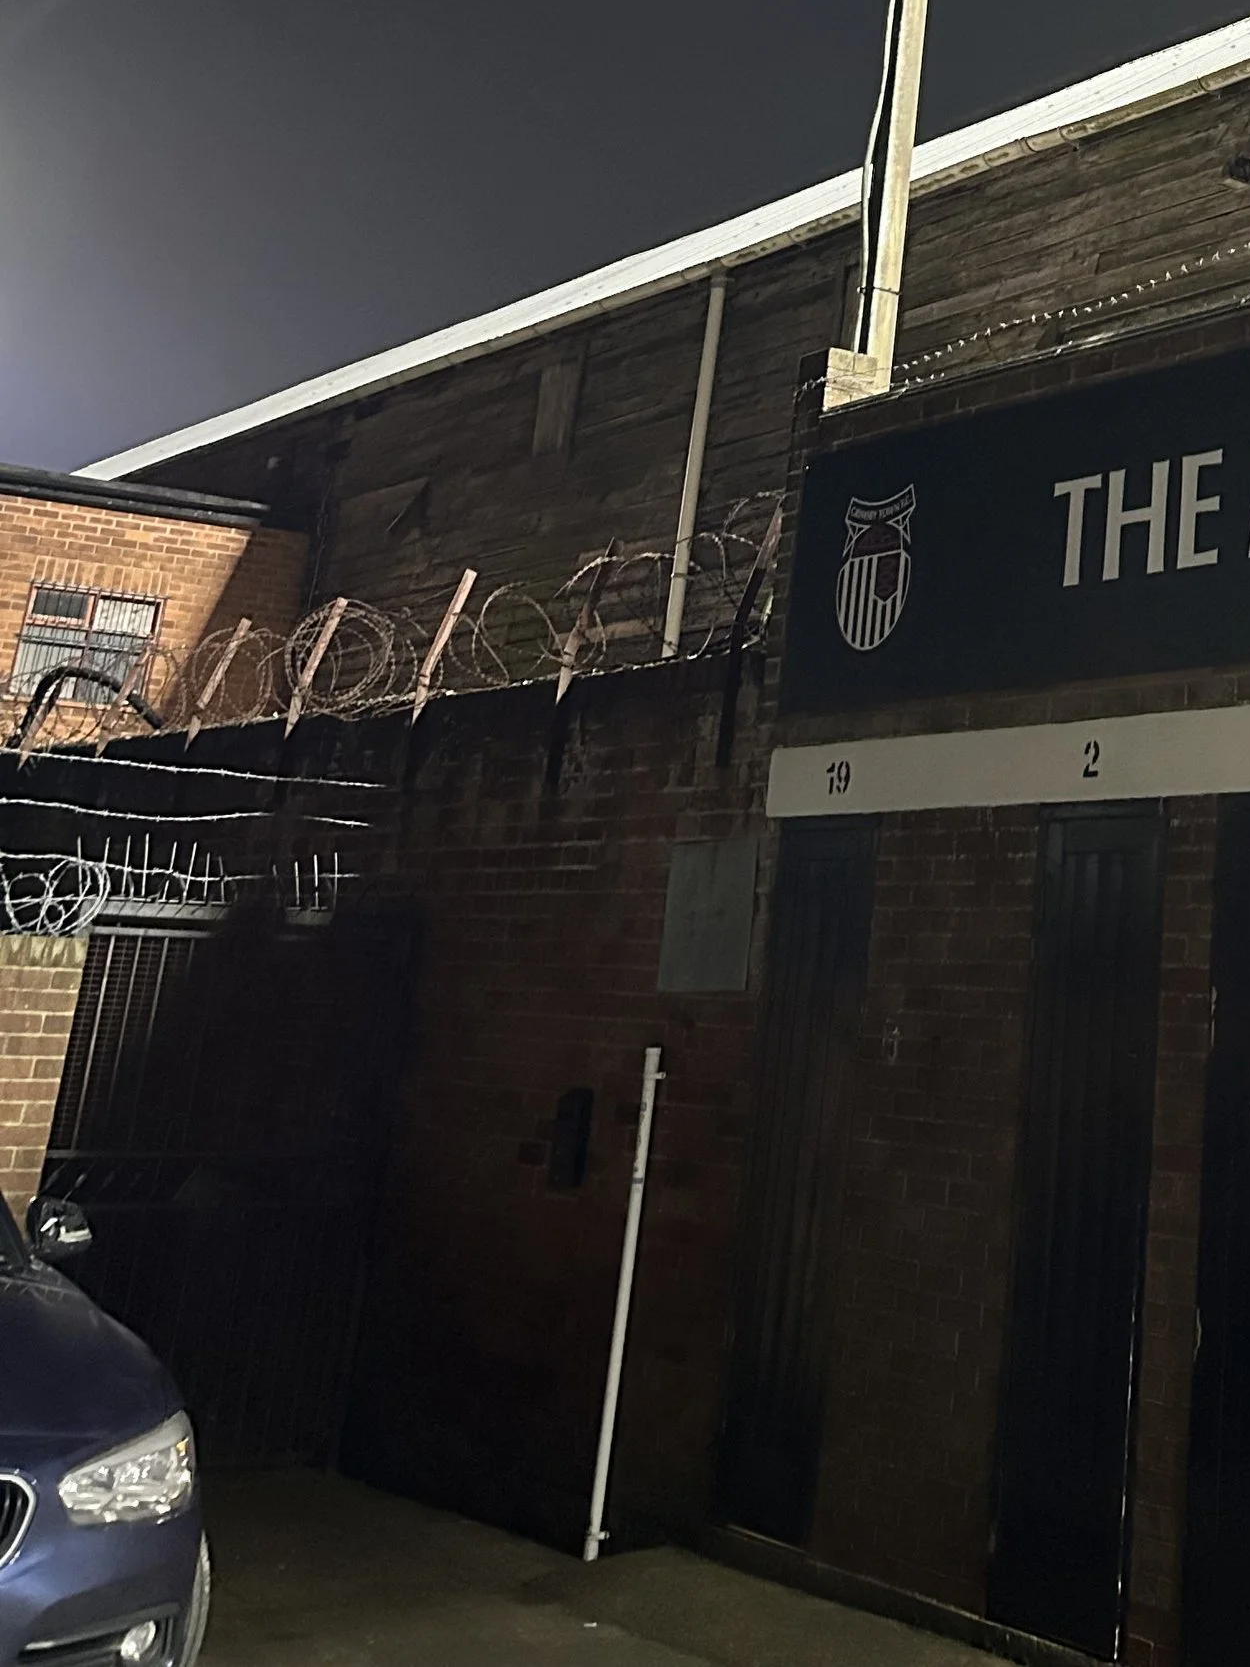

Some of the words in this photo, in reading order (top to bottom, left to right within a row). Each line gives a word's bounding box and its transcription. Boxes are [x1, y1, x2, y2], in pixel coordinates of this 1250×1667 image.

[1053, 448, 1224, 588] THE
[826, 760, 851, 795] 19
[1082, 740, 1100, 778] 2
